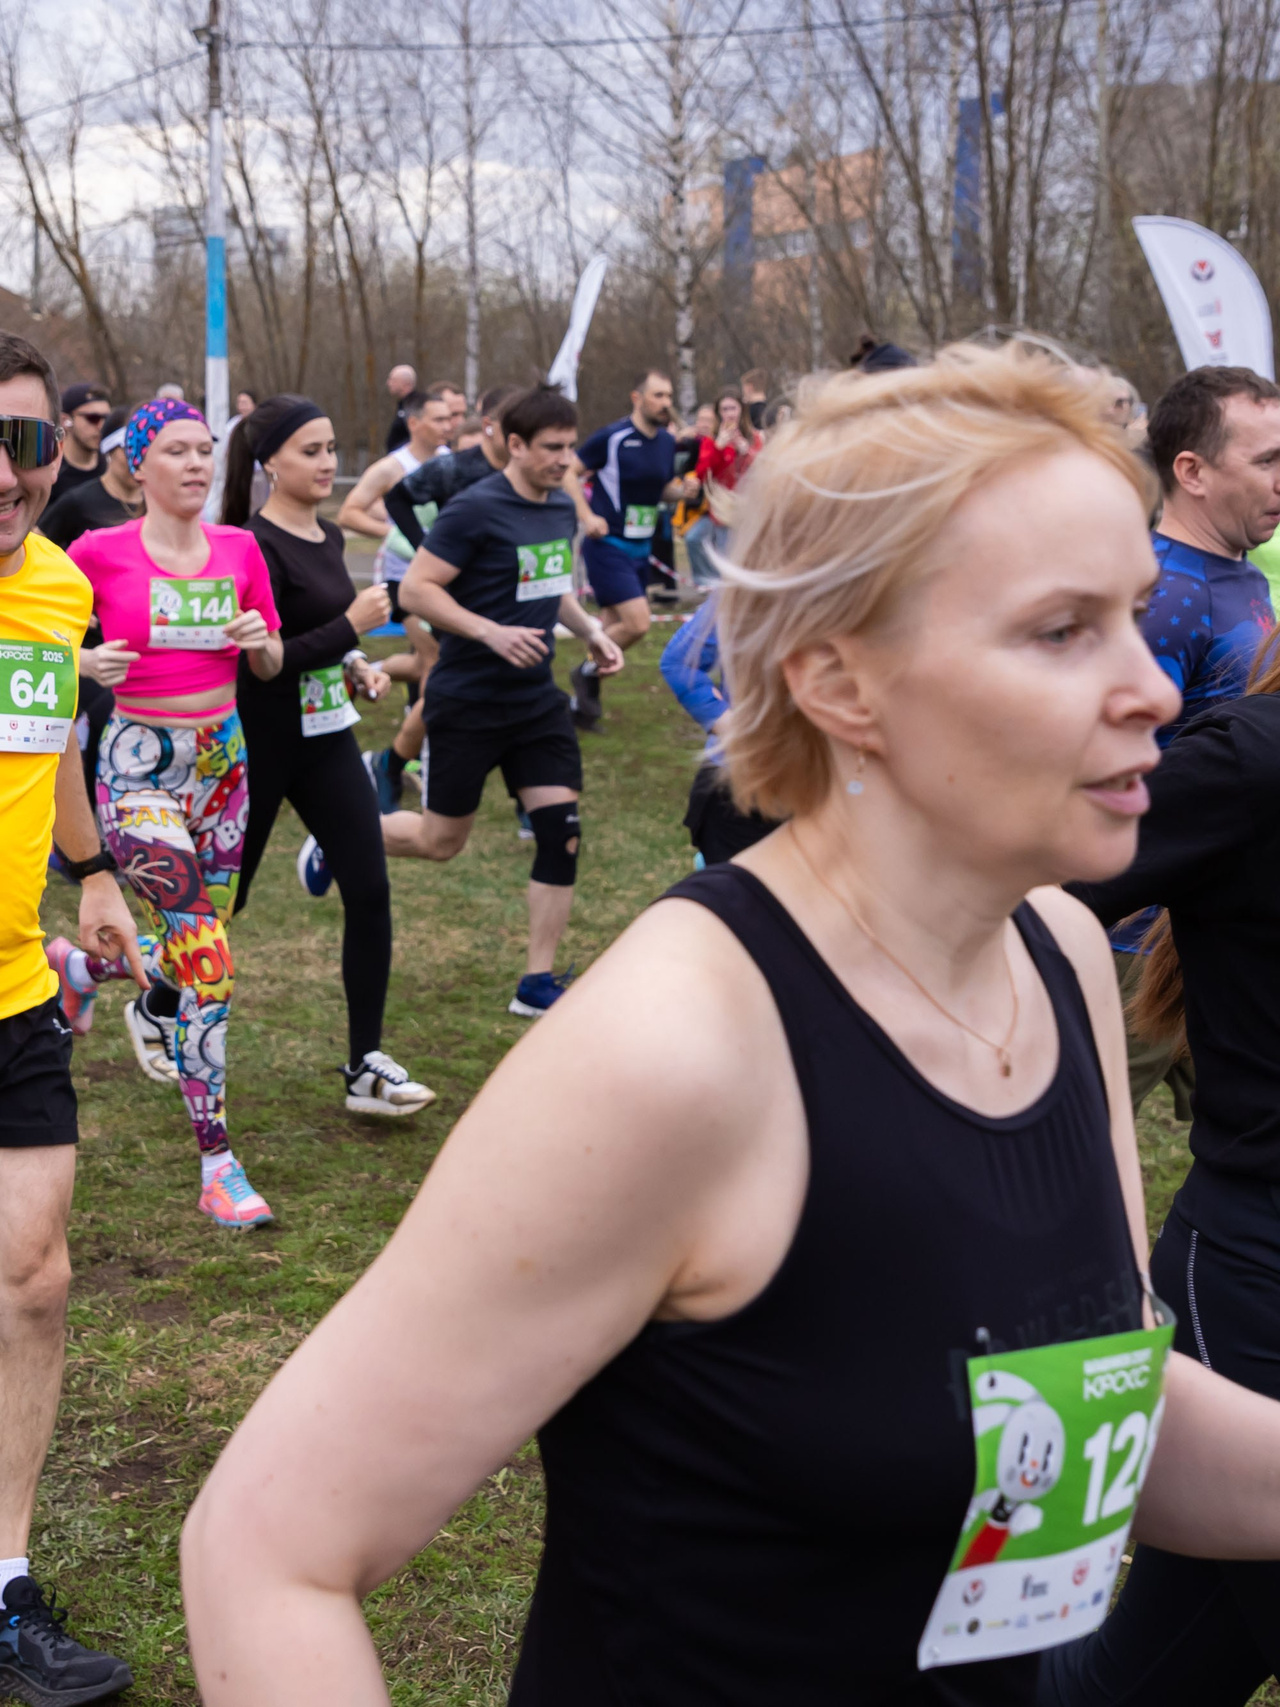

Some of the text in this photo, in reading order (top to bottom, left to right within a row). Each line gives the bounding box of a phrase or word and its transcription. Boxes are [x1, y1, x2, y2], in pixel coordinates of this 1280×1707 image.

[188, 594, 233, 623] 144
[42, 650, 64, 664] 2025
[10, 669, 58, 710] 64
